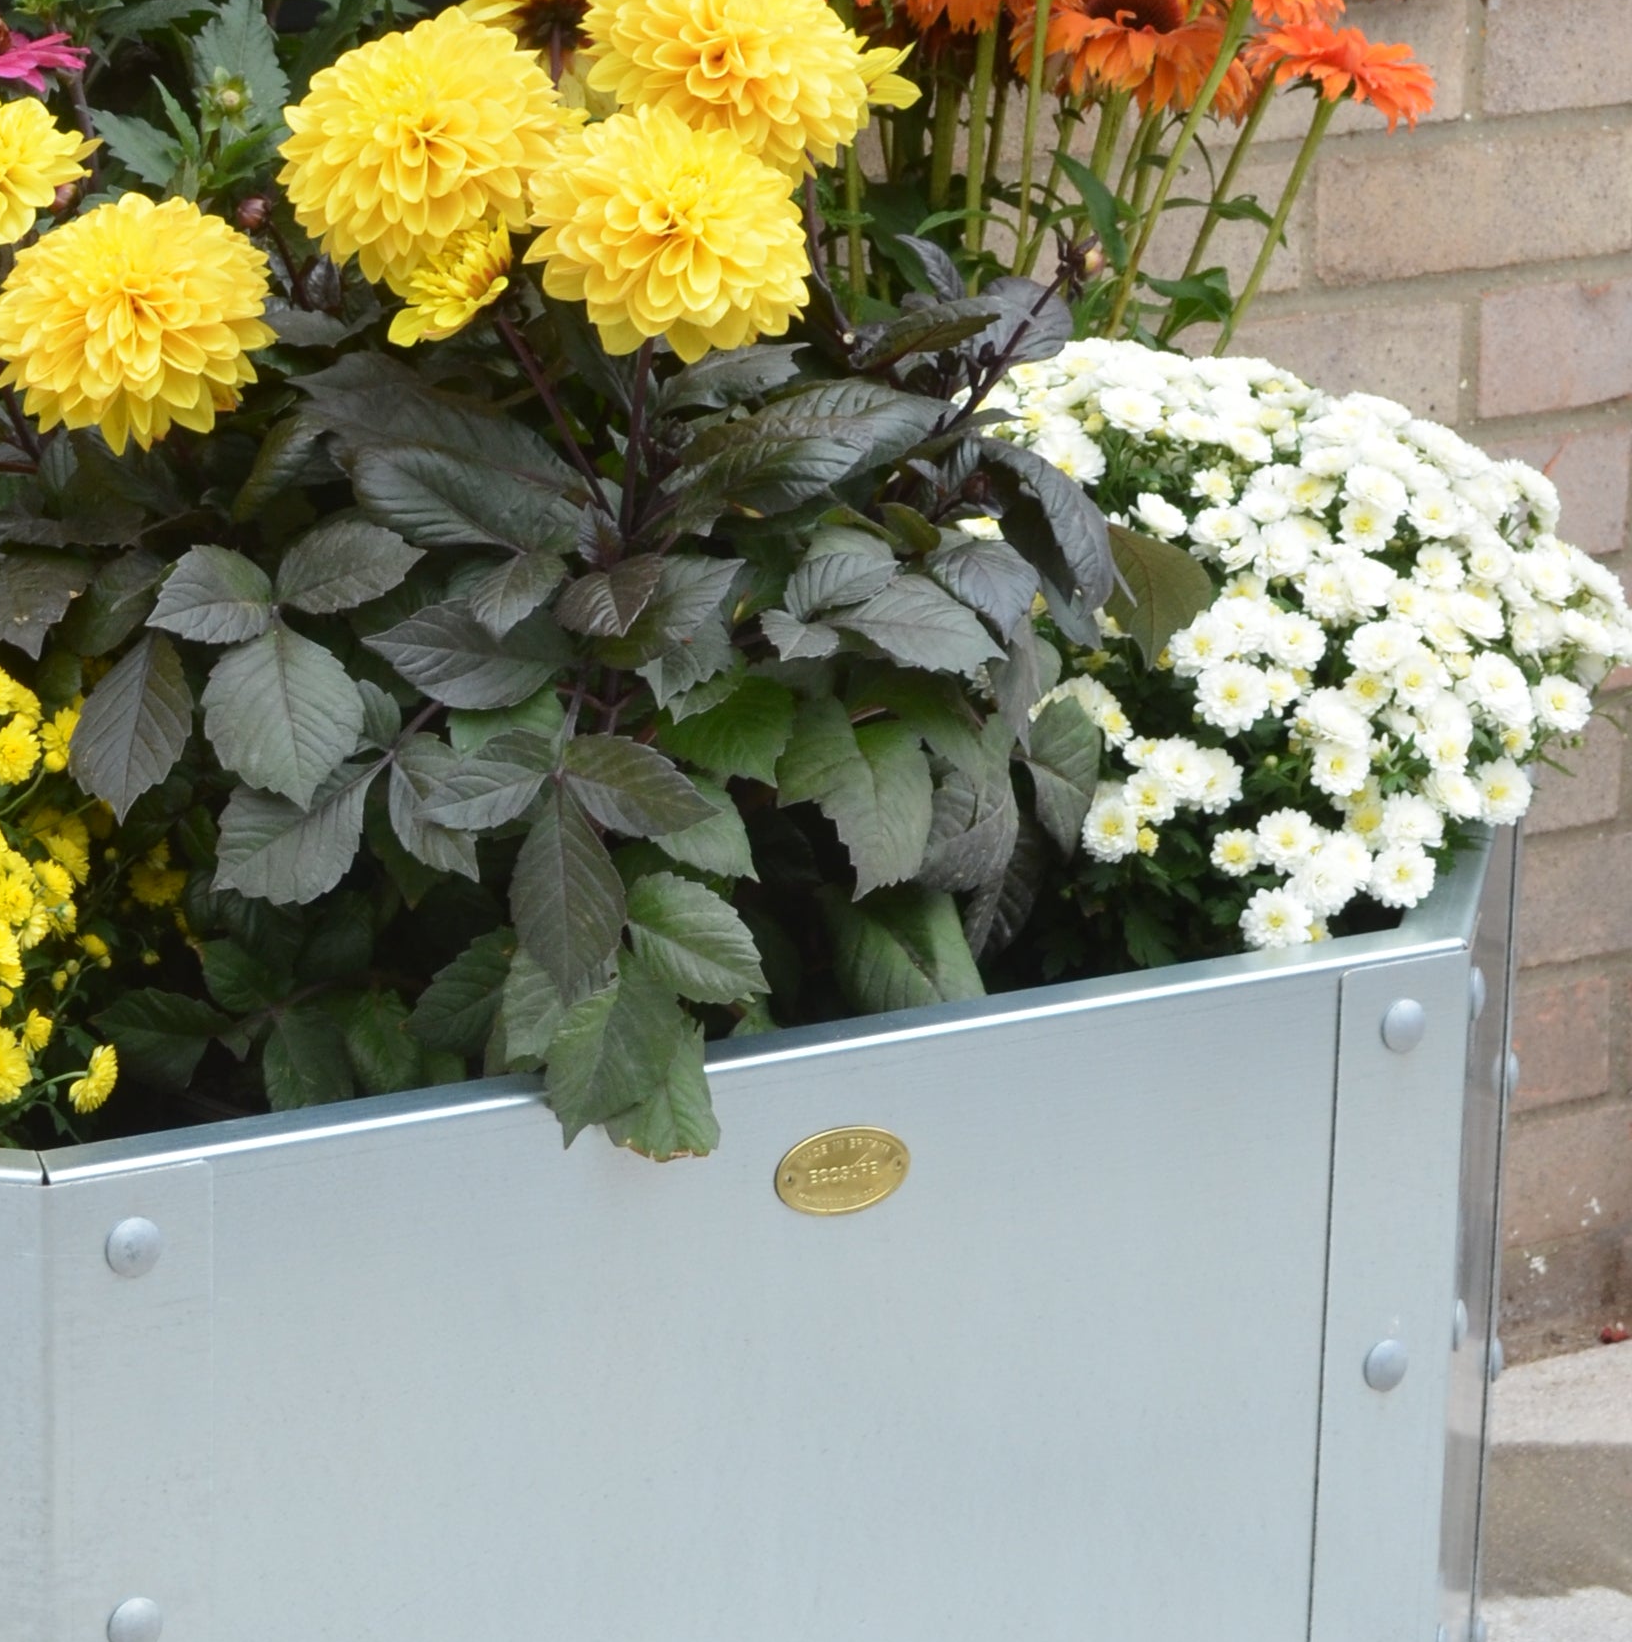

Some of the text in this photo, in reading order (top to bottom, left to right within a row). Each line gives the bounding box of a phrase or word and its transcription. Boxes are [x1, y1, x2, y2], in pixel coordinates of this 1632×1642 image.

[798, 1137, 891, 1163] MADE IN BRITAIN
[808, 1159, 879, 1185] ECOSURE
